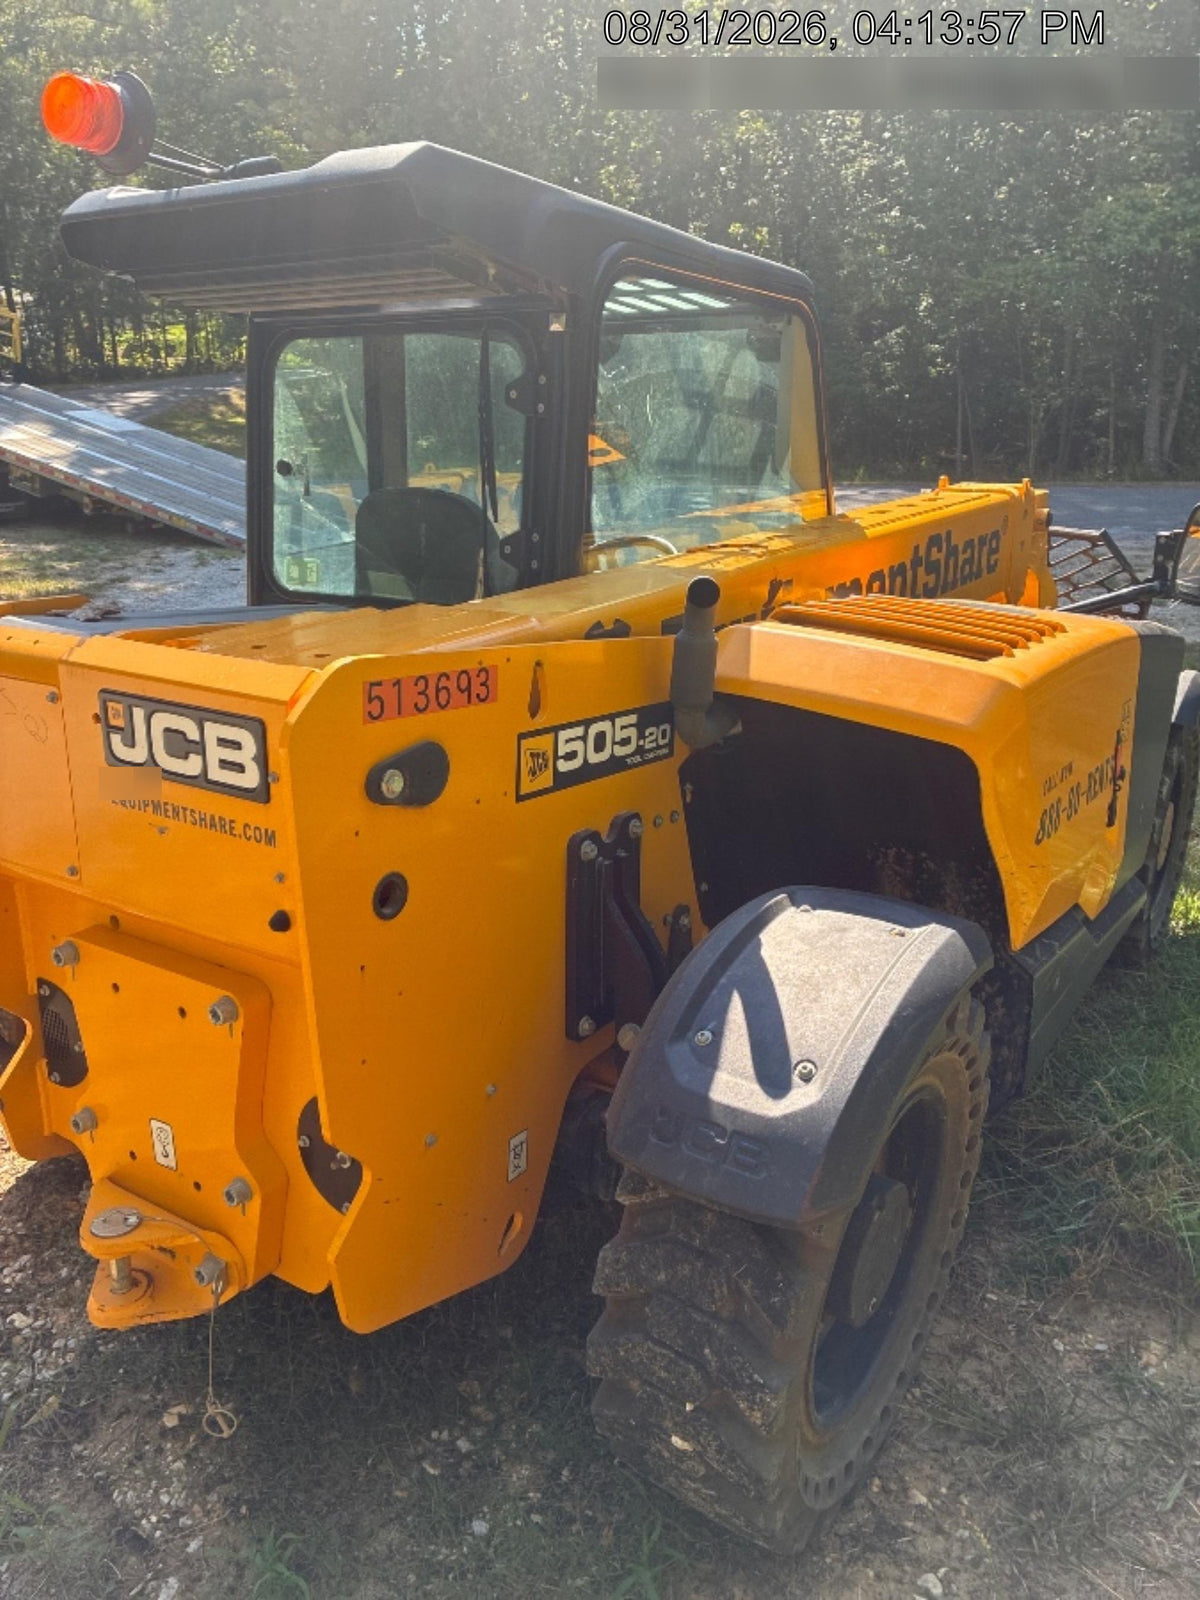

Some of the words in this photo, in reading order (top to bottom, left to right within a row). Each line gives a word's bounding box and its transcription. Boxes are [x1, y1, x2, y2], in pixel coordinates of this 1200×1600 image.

[366, 666, 491, 721] 513693
[108, 705, 261, 789] JCB
[110, 799, 277, 849] QUIPMENTSHARE.COM
